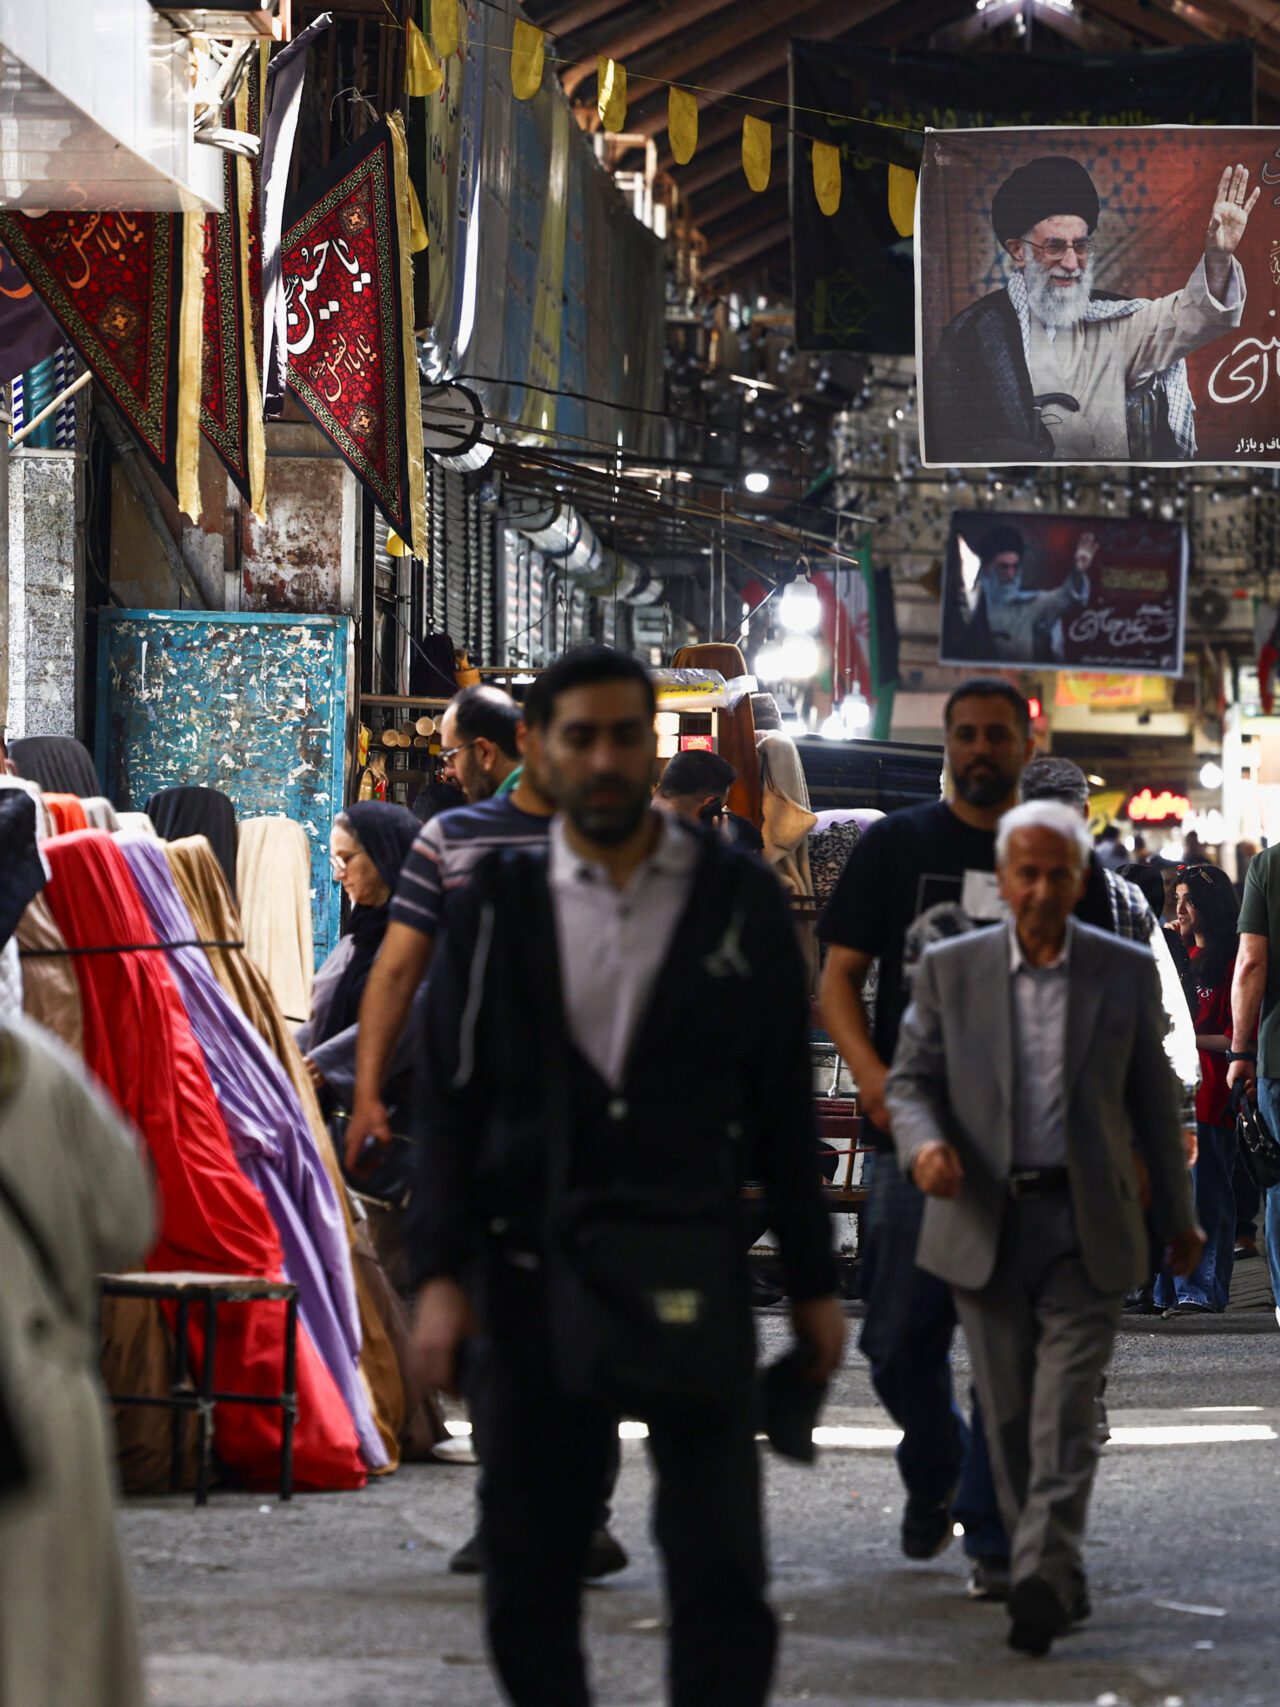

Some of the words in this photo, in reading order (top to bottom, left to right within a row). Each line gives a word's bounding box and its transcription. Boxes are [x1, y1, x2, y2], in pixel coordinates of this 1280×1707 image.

[332, 238, 371, 293] یا
[1235, 438, 1258, 453] بازار
[1259, 442, 1265, 453] و
